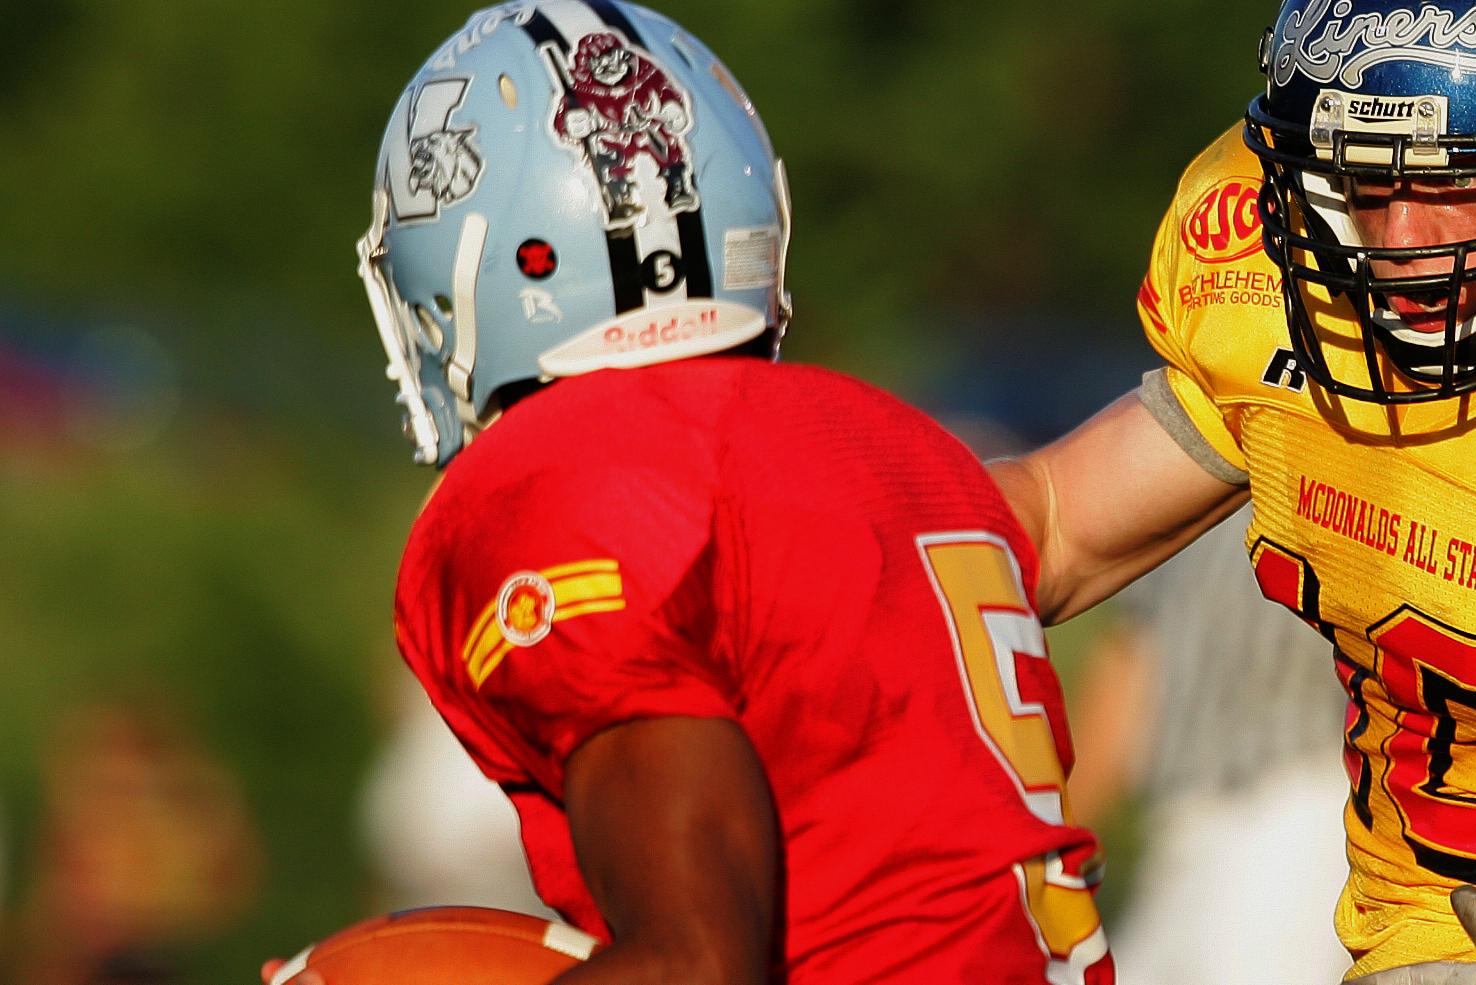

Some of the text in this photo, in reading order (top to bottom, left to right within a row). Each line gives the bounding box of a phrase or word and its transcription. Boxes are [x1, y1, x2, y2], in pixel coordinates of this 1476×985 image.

[1348, 97, 1415, 117] schutt
[654, 253, 676, 288] 5
[1230, 291, 1281, 308] GOODS
[1297, 475, 1400, 556] MCDONALDS
[1403, 521, 1437, 575] ALL
